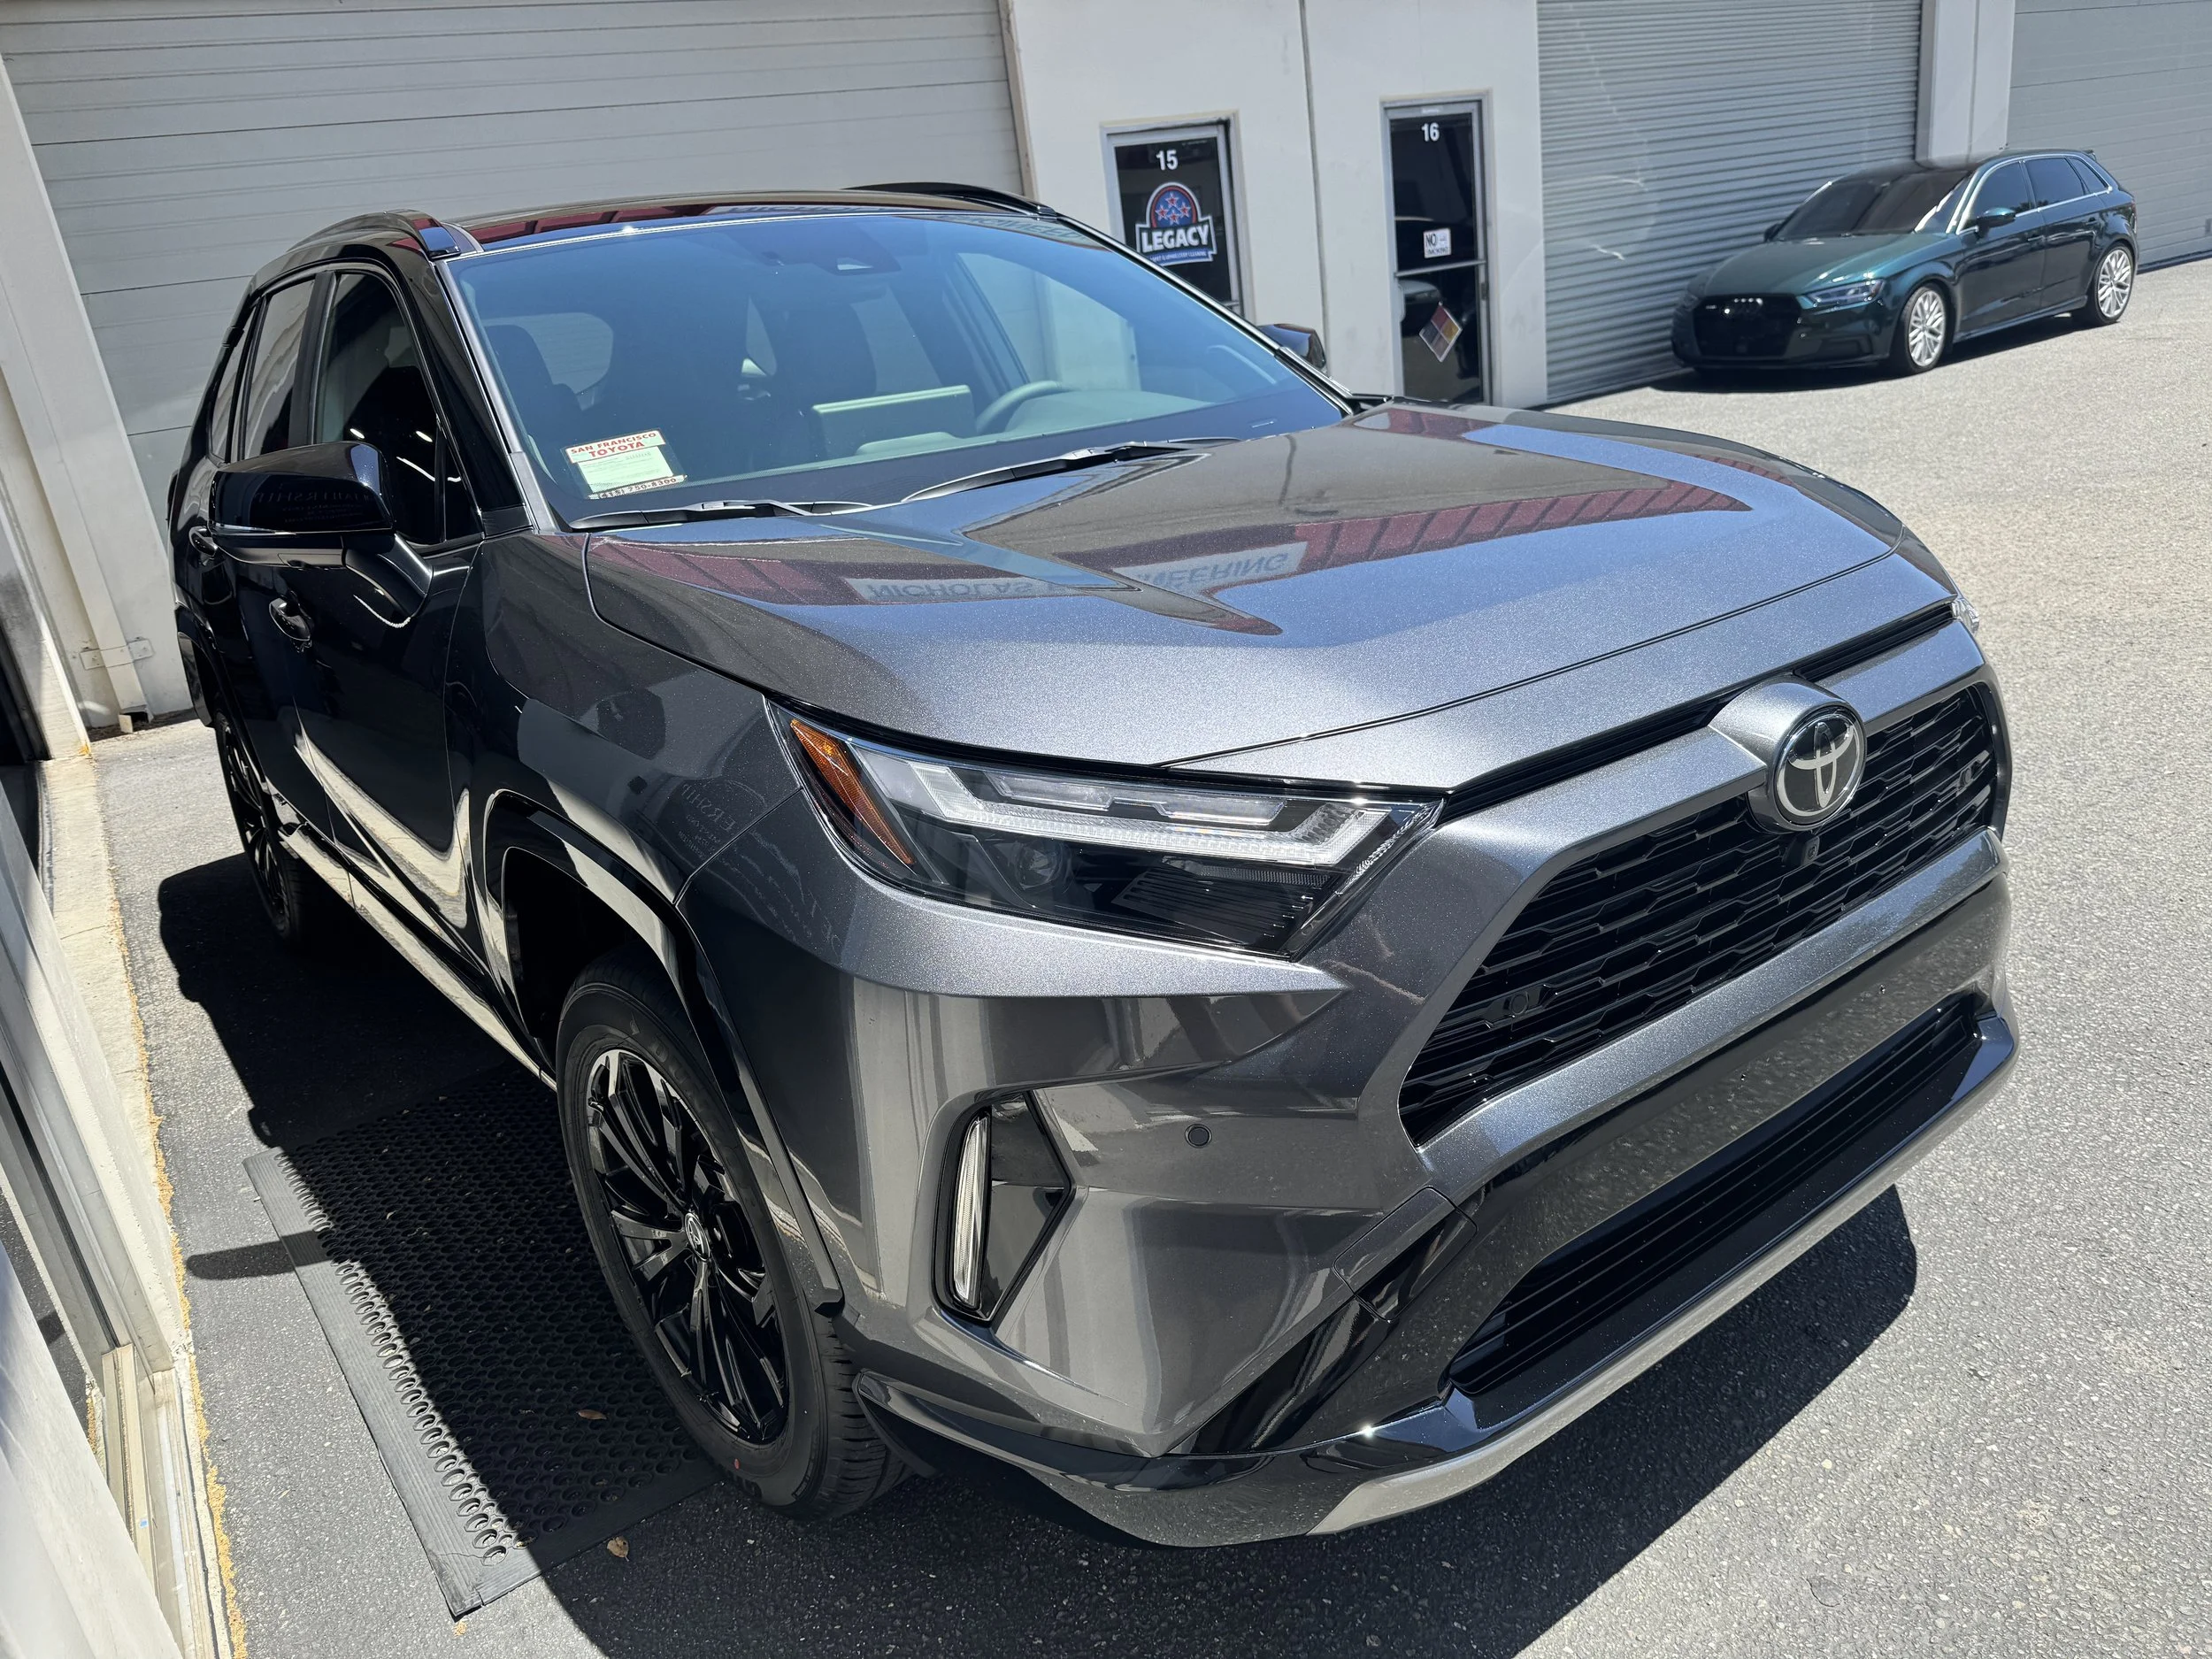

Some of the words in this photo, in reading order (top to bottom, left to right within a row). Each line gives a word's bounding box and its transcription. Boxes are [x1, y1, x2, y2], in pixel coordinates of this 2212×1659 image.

[1421, 122, 1440, 142] 16
[1156, 149, 1179, 171] 15
[1141, 224, 1209, 253] LEGACY
[1425, 233, 1437, 247] NO
[571, 445, 594, 454] SAN
[597, 433, 657, 449] FRANCISCO
[588, 442, 645, 457] TOYOTA
